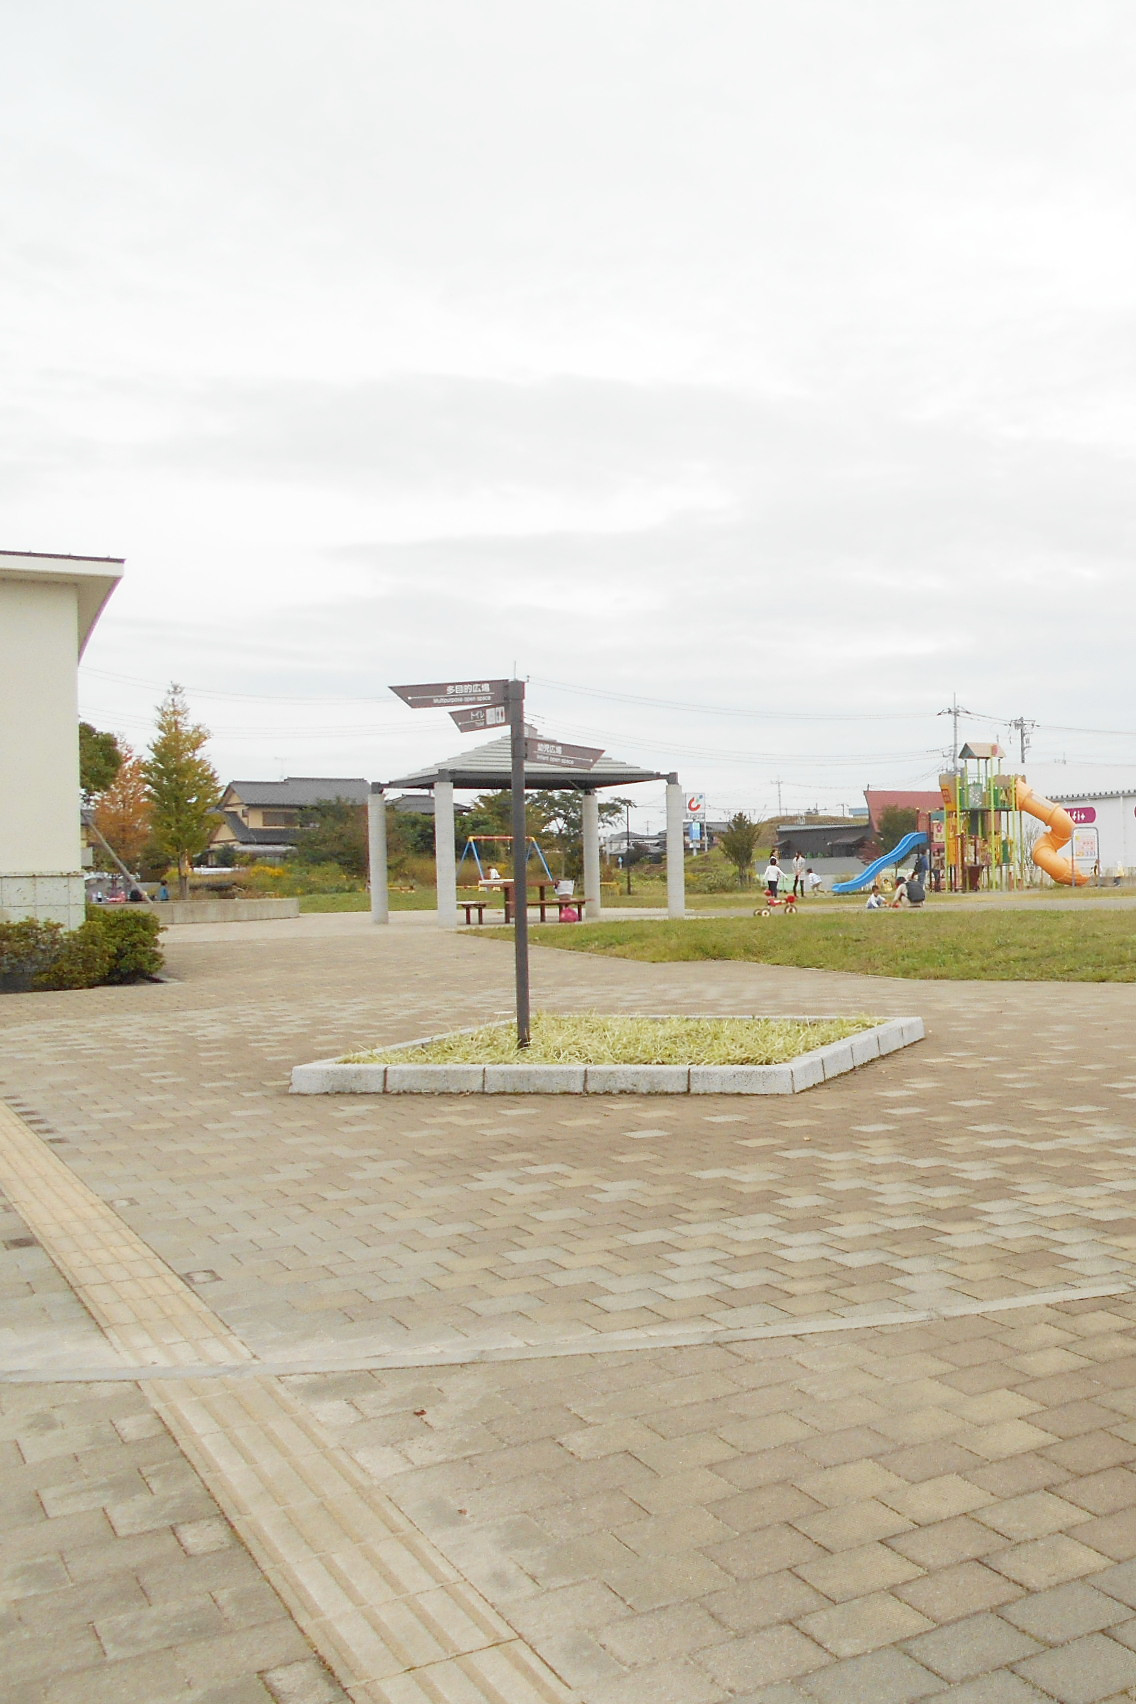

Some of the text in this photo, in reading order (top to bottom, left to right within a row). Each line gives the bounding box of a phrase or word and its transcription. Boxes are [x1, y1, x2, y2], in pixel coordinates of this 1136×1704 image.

[446, 684, 490, 694] 多目的広場
[470, 710, 485, 720] トイレ
